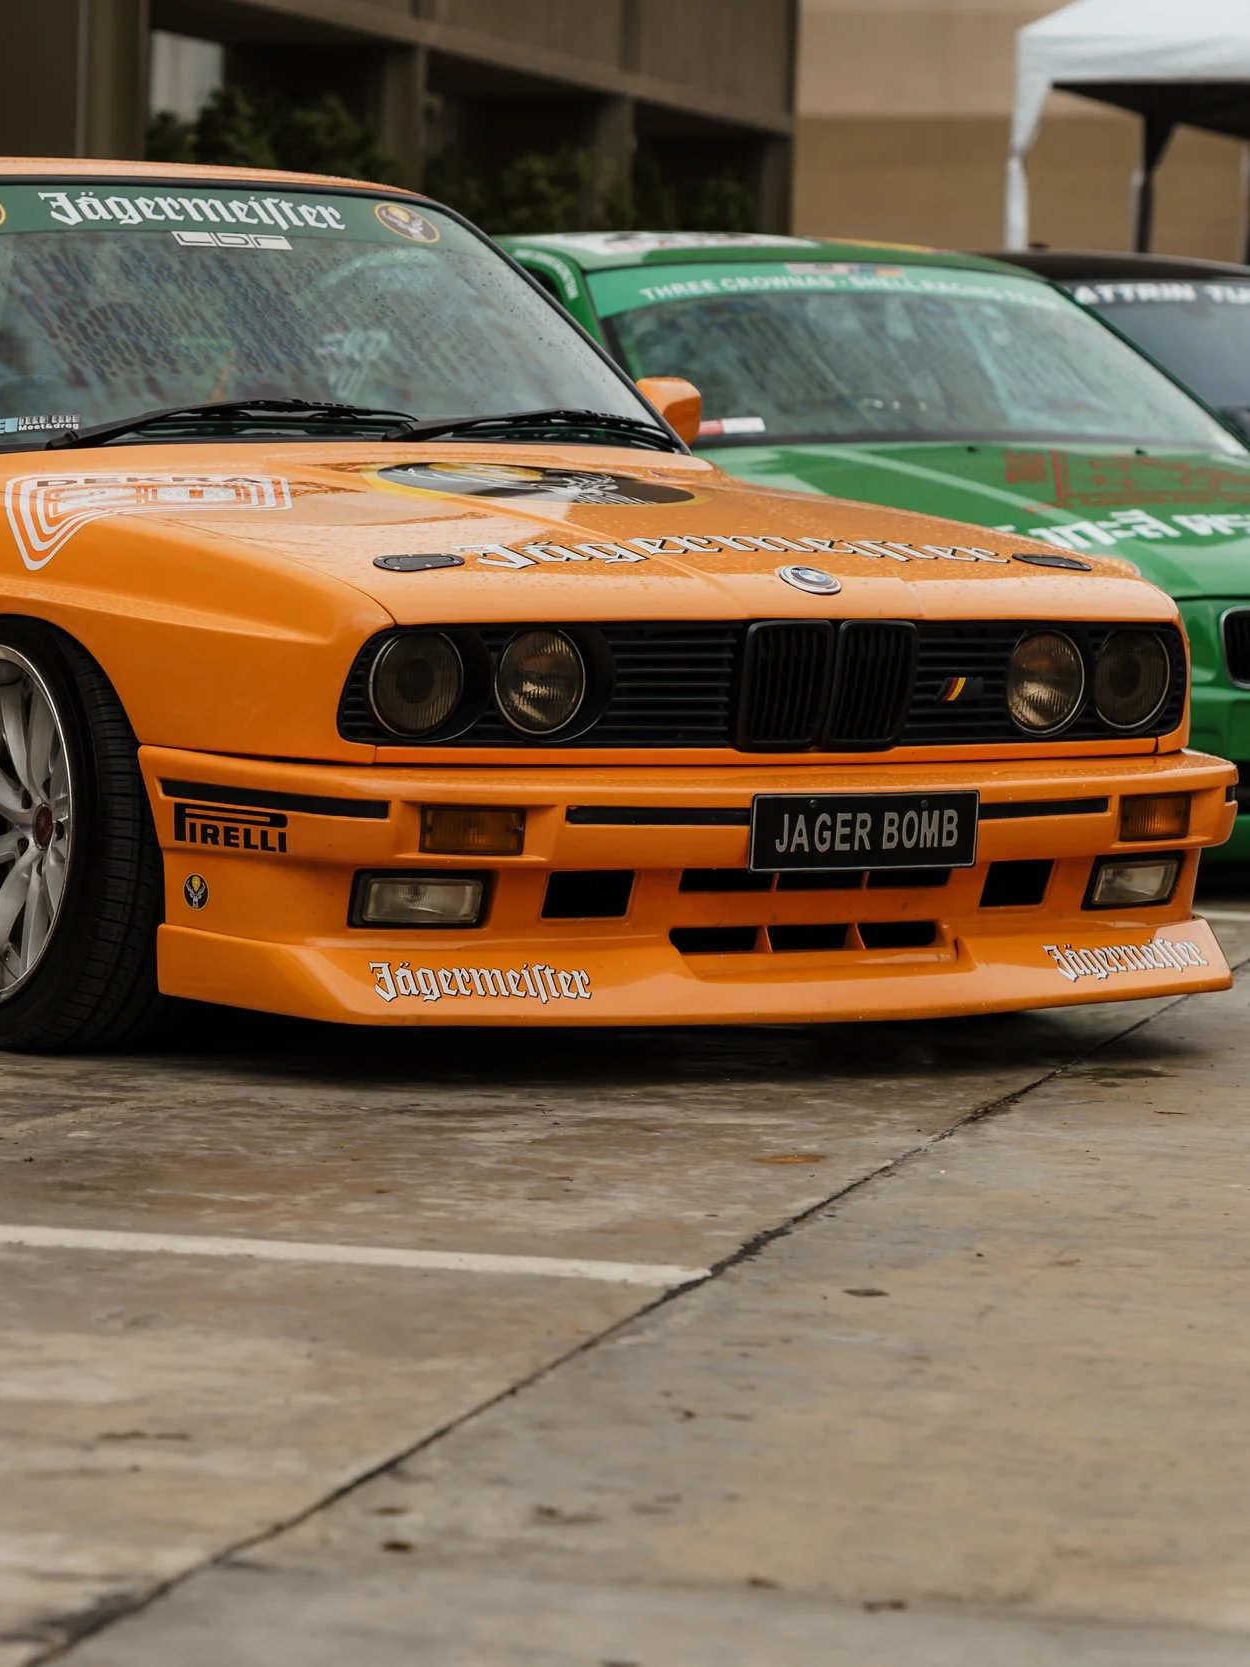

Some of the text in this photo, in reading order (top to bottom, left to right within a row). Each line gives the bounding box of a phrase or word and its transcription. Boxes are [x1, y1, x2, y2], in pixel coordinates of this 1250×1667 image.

[173, 801, 288, 853] PIRELLI
[774, 808, 960, 854] JAGER BOMB
